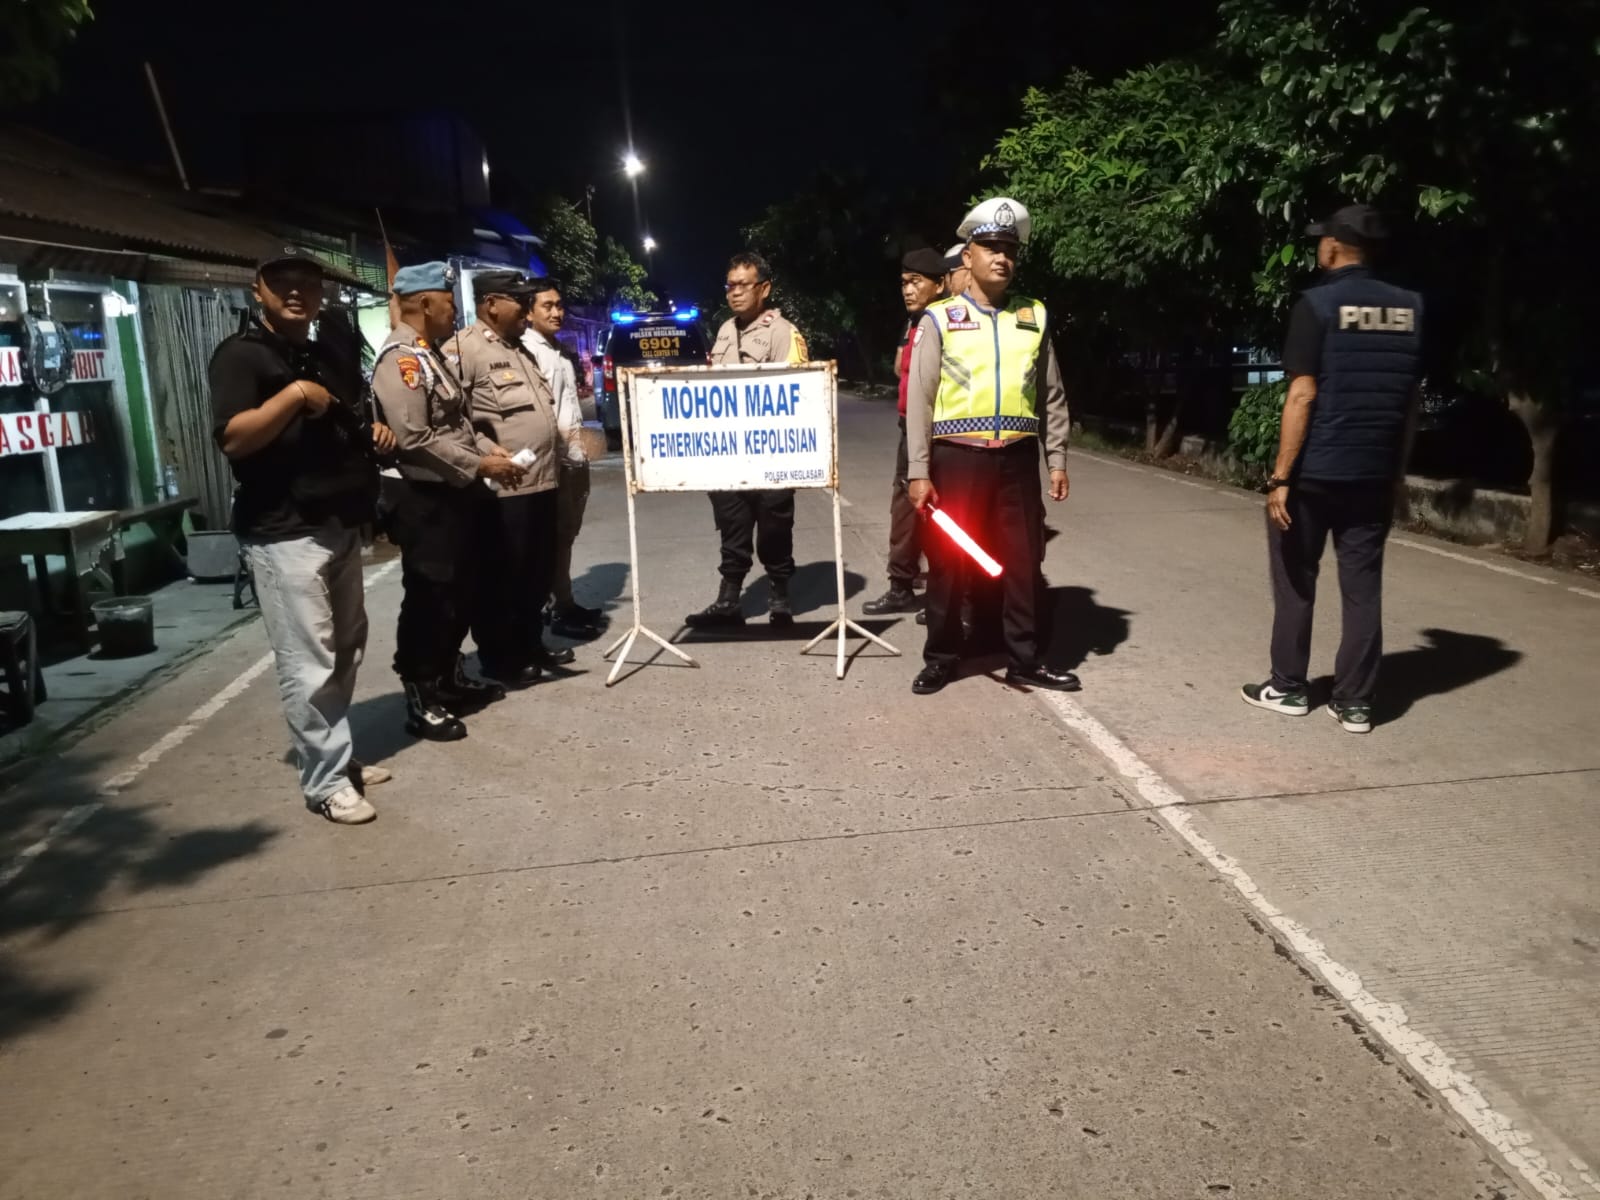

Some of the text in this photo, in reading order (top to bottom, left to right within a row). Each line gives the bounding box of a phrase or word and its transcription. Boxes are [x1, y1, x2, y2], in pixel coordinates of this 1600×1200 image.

[1339, 305, 1415, 332] POLISI
[639, 337, 680, 350] 6901
[662, 383, 800, 420] MOHON MAAF
[650, 428, 817, 458] PEMERIKSAAN KEPOLISIAN
[764, 469, 824, 481] POLSEK NEGLASARI
